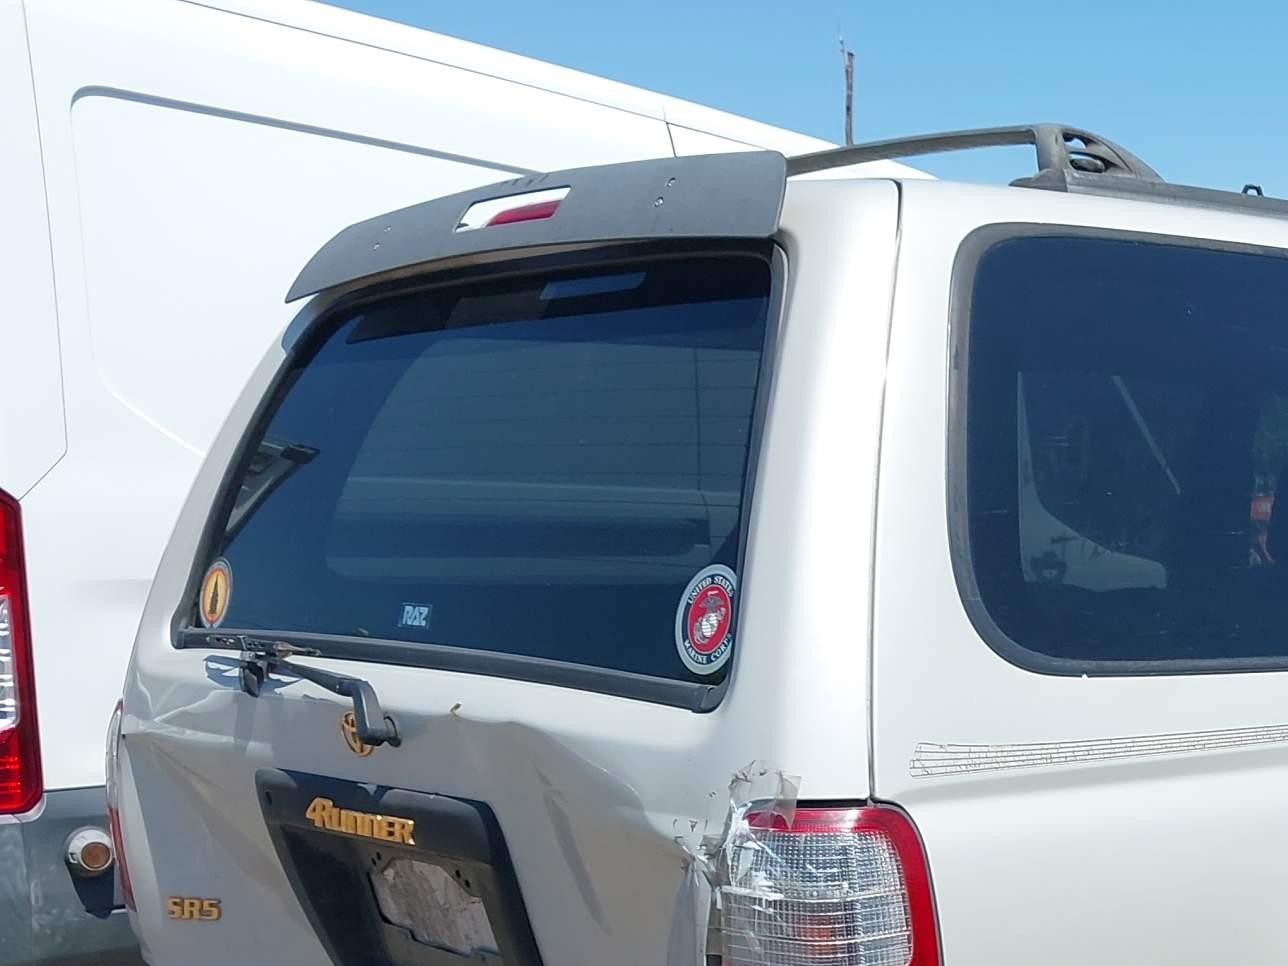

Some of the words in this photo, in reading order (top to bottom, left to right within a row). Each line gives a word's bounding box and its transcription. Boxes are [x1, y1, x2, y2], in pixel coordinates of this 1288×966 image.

[687, 577, 712, 604] UNITED
[684, 639, 708, 664] MARINE
[167, 897, 222, 921] SR5
